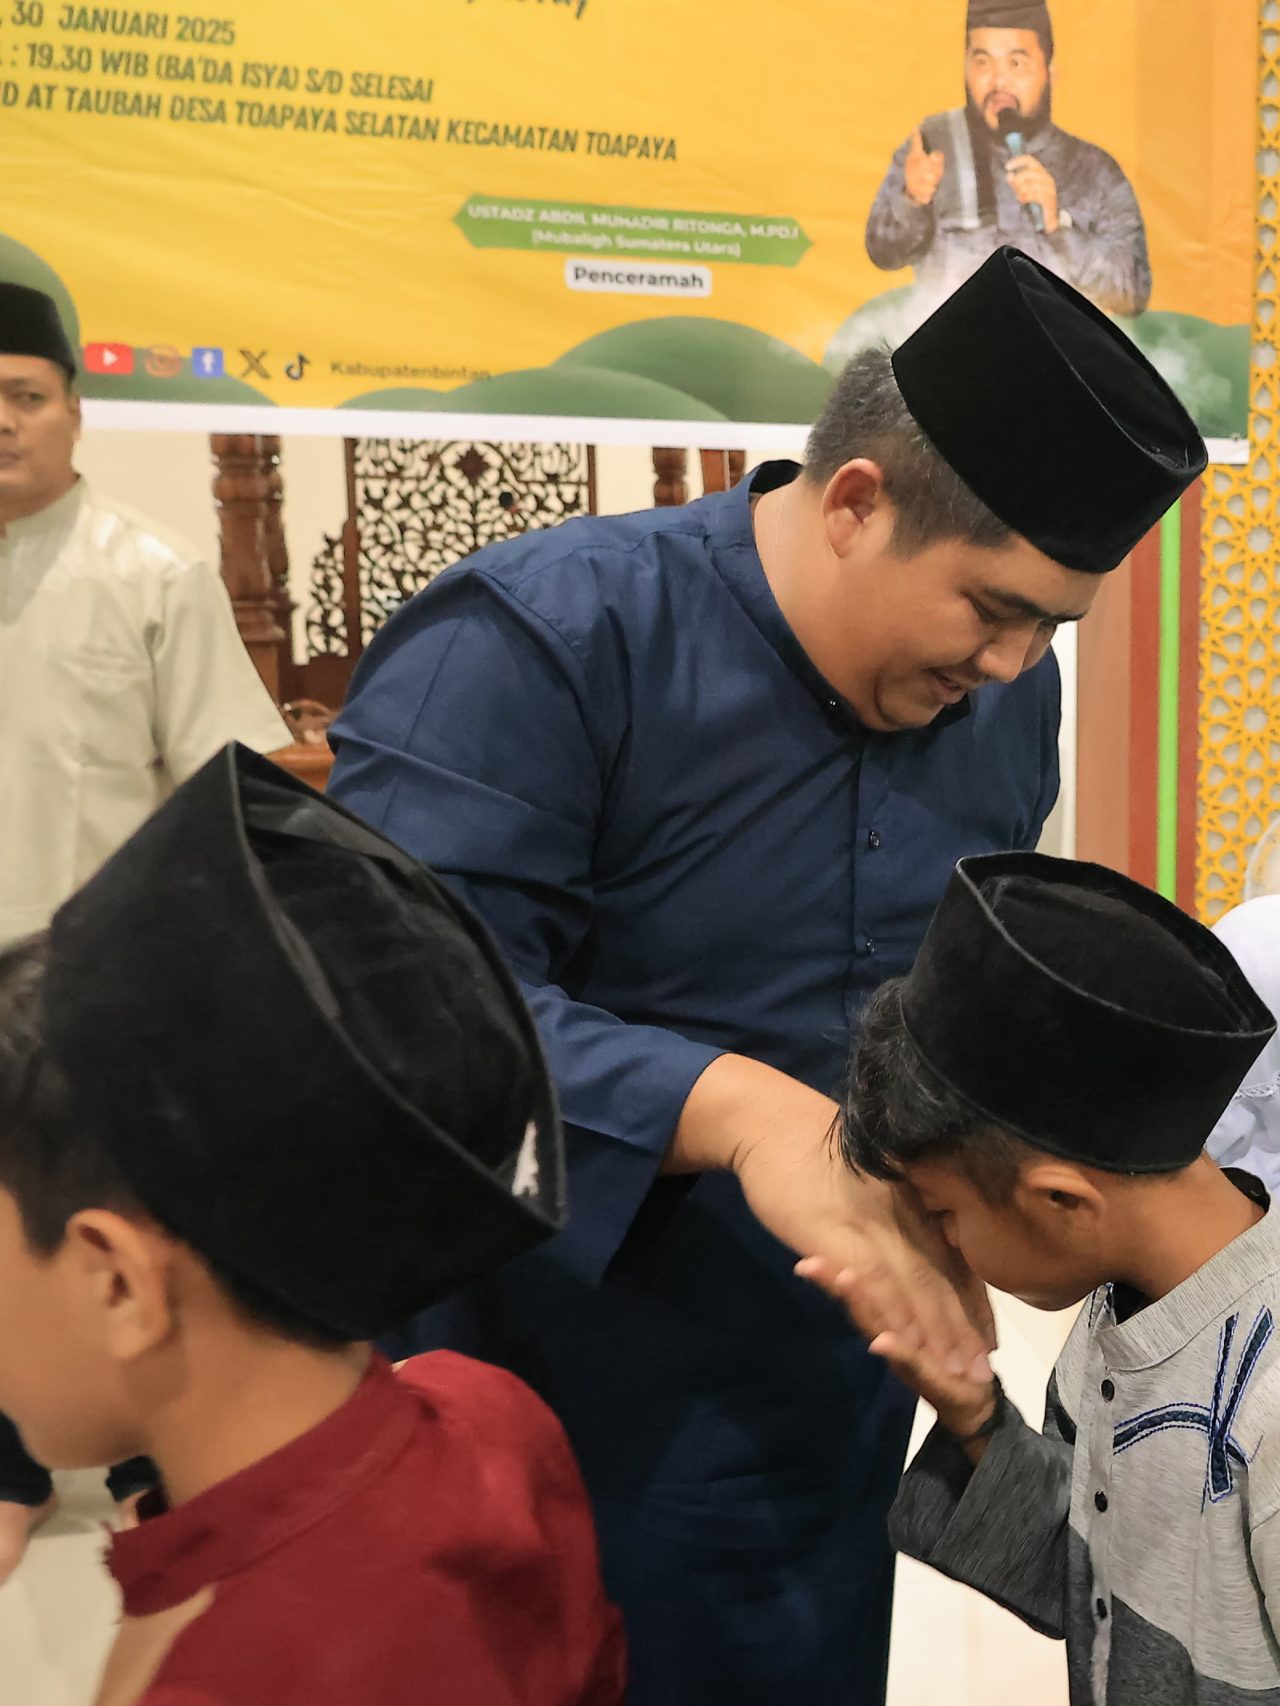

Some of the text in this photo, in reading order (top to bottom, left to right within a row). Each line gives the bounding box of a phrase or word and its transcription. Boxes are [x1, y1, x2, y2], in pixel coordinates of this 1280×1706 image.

[11, 0, 236, 46] 30 JANUARI 2025
[27, 42, 93, 73] 19.30
[101, 49, 149, 78] WIB
[241, 60, 300, 92] ISYA)
[305, 67, 344, 95] S/D
[350, 71, 434, 103] SELESAI
[26, 82, 57, 111] AT
[66, 85, 162, 119] TAUBAH
[169, 95, 227, 124] DESA
[236, 100, 337, 134] TOAPAYA
[344, 109, 441, 142] SELATAN
[446, 117, 578, 154] KECAMATAN
[585, 130, 678, 162] TOAPAYA
[468, 204, 536, 223] USTADZ
[671, 217, 747, 238] RITONGA,
[614, 234, 692, 253] Sumatera
[574, 265, 704, 289] Penceramah
[330, 360, 492, 382] Kabupatenbintan
